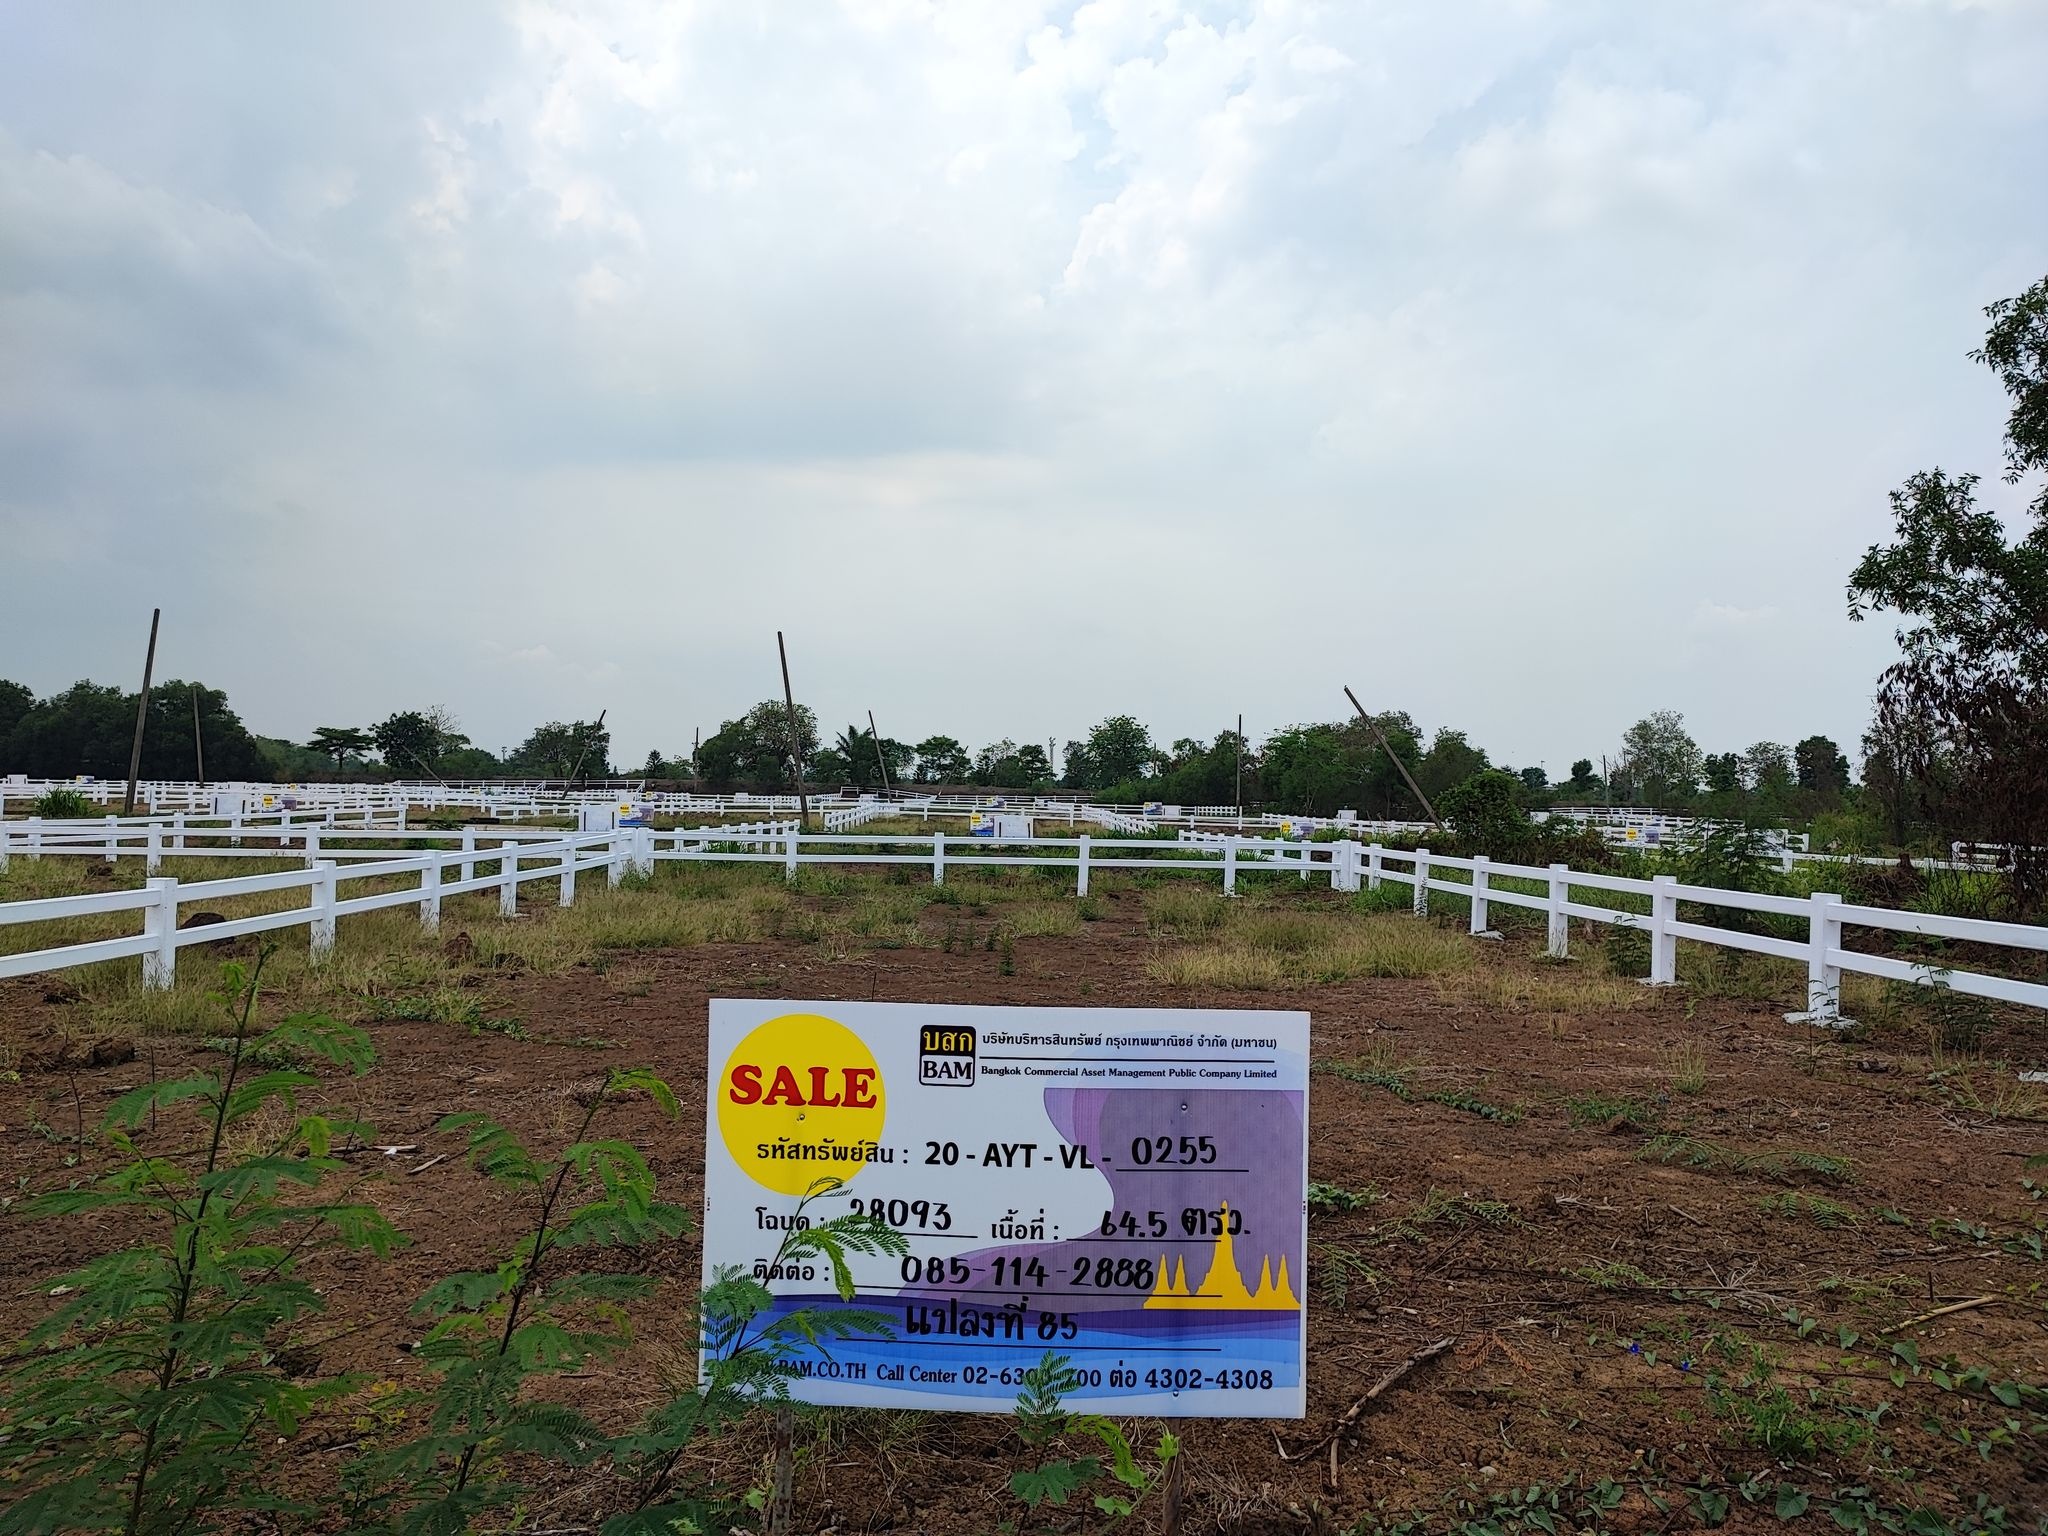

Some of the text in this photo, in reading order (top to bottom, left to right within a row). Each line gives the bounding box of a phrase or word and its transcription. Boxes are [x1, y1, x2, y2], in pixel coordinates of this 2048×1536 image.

[923, 1031, 973, 1052] บสก
[982, 1031, 1277, 1050] บริษัทบริหารสินทรัพย์ กรุงเทพพาณิชย์ จำกัด (มหาชน)
[923, 1060, 972, 1080] BAM
[981, 1065, 1277, 1080] Bangkok Commercial Asset Management Public Company Limited
[729, 1064, 878, 1109] SALE
[756, 1136, 894, 1164] รหัสทรัพย์สิน
[924, 1140, 960, 1166] 20
[982, 1142, 1038, 1168] AYT
[1059, 1144, 1095, 1170] VL
[1131, 1135, 1218, 1166] 0255
[850, 1198, 952, 1231] 28093
[991, 1208, 1045, 1240] เนื้อที่
[1101, 1210, 1168, 1238] 64.5
[753, 1257, 815, 1281] ติดต่อ
[901, 1255, 1155, 1290] 085-114-2888
[906, 1295, 1079, 1341] แปลงที่ 85
[876, 1363, 904, 1382] Call
[909, 1365, 958, 1383] Center
[1109, 1359, 1137, 1389] ต่อ
[1144, 1368, 1274, 1391] 4302-4308
